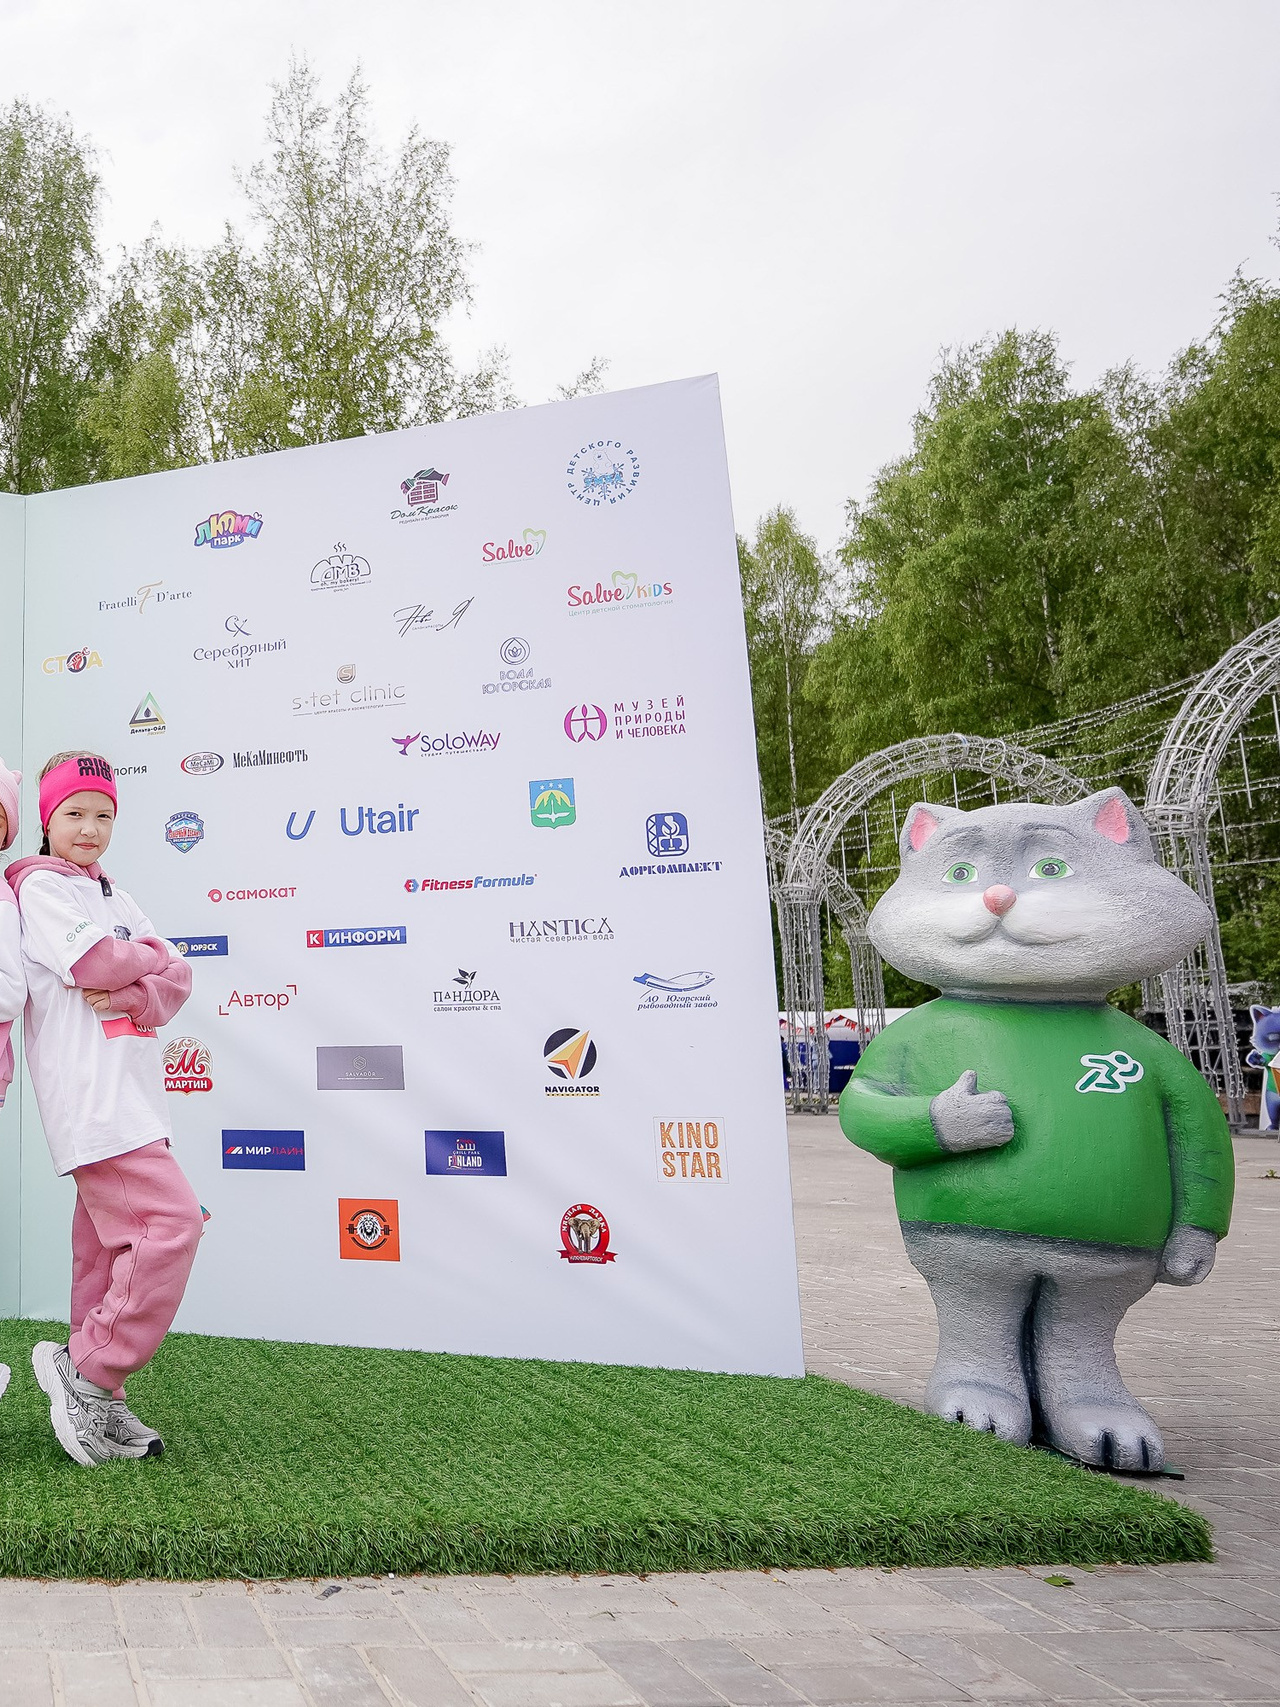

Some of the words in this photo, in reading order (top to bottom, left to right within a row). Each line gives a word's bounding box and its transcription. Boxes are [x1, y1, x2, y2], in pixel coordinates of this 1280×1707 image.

[566, 440, 622, 476] ДЕТСКОГО
[609, 449, 641, 505] РАЗВИТИЯ
[213, 534, 242, 547] парк
[482, 538, 535, 562] Salve
[567, 582, 625, 607] Salve
[98, 596, 138, 612] Fratelli
[568, 609, 591, 617] Центр
[591, 605, 620, 615] детской
[621, 599, 674, 610] стоматологии
[193, 638, 287, 662] Серебряный
[499, 667, 534, 681] ВОДА
[350, 683, 406, 703] clinic
[481, 677, 552, 695] ЮГОРСКАЯ
[614, 694, 685, 713] МУЗЕЙ
[614, 710, 686, 727] ПРИРОДЫ
[615, 729, 624, 740] И
[627, 723, 687, 738] ЧЕЛОВЕКА
[232, 749, 309, 769] МеКаМинефть
[339, 802, 421, 838] Utair
[618, 861, 723, 879] ДОРКОМПЛЕКТ
[509, 917, 614, 938] HANTICA
[309, 933, 320, 945] К
[328, 929, 401, 945] ИНФОРМ
[510, 936, 541, 944] чистая
[545, 934, 588, 943] северная
[592, 933, 615, 941] вода
[190, 942, 218, 952] ЮРЭСК
[226, 989, 290, 1011] Автор
[433, 989, 501, 1003] ПАНДОРА
[666, 994, 711, 1004] Югорский
[453, 1005, 480, 1013] красоты
[637, 1001, 692, 1011] рыбоводный
[694, 1000, 718, 1008] завод
[165, 1080, 208, 1089] МАРТИН
[544, 1085, 600, 1093] NAVIGATOR
[659, 1121, 719, 1149] KINO
[447, 1155, 483, 1168] FINLAND
[661, 1150, 723, 1179] STAR
